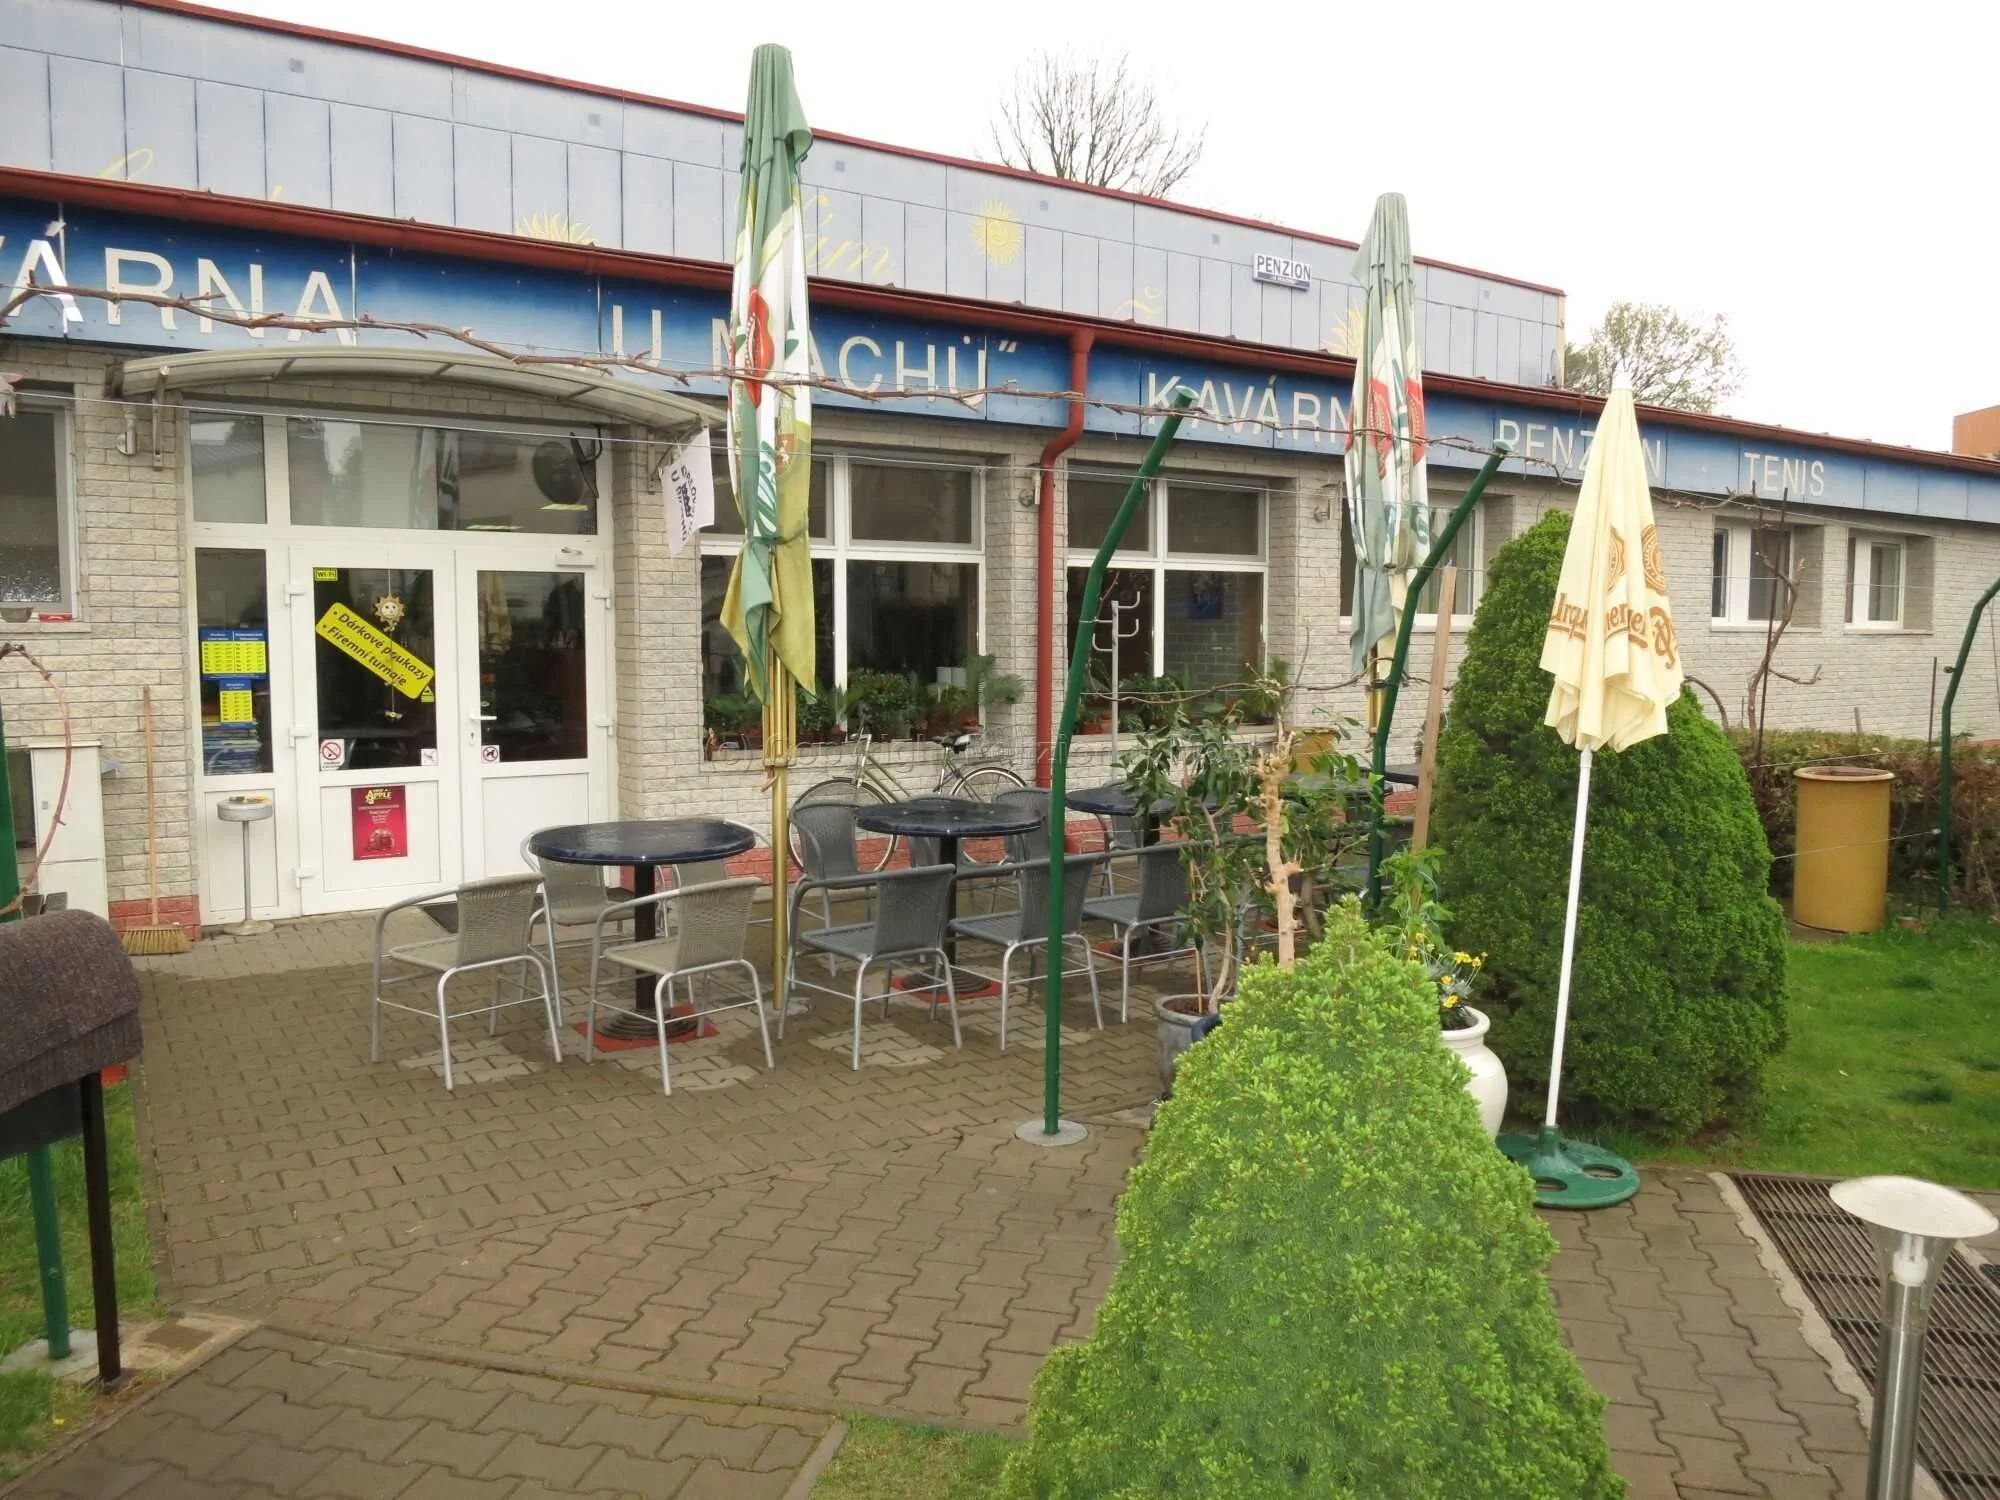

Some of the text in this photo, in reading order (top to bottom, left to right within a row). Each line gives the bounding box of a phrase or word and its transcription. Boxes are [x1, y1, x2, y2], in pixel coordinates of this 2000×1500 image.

[0, 220, 357, 346] ÁRNA
[612, 304, 662, 375] U
[1257, 255, 1311, 281] PENZION
[1744, 452, 1825, 497] TENIS
[327, 626, 407, 686] Firemní turnaje
[338, 612, 428, 681] Dárkové poukazy
